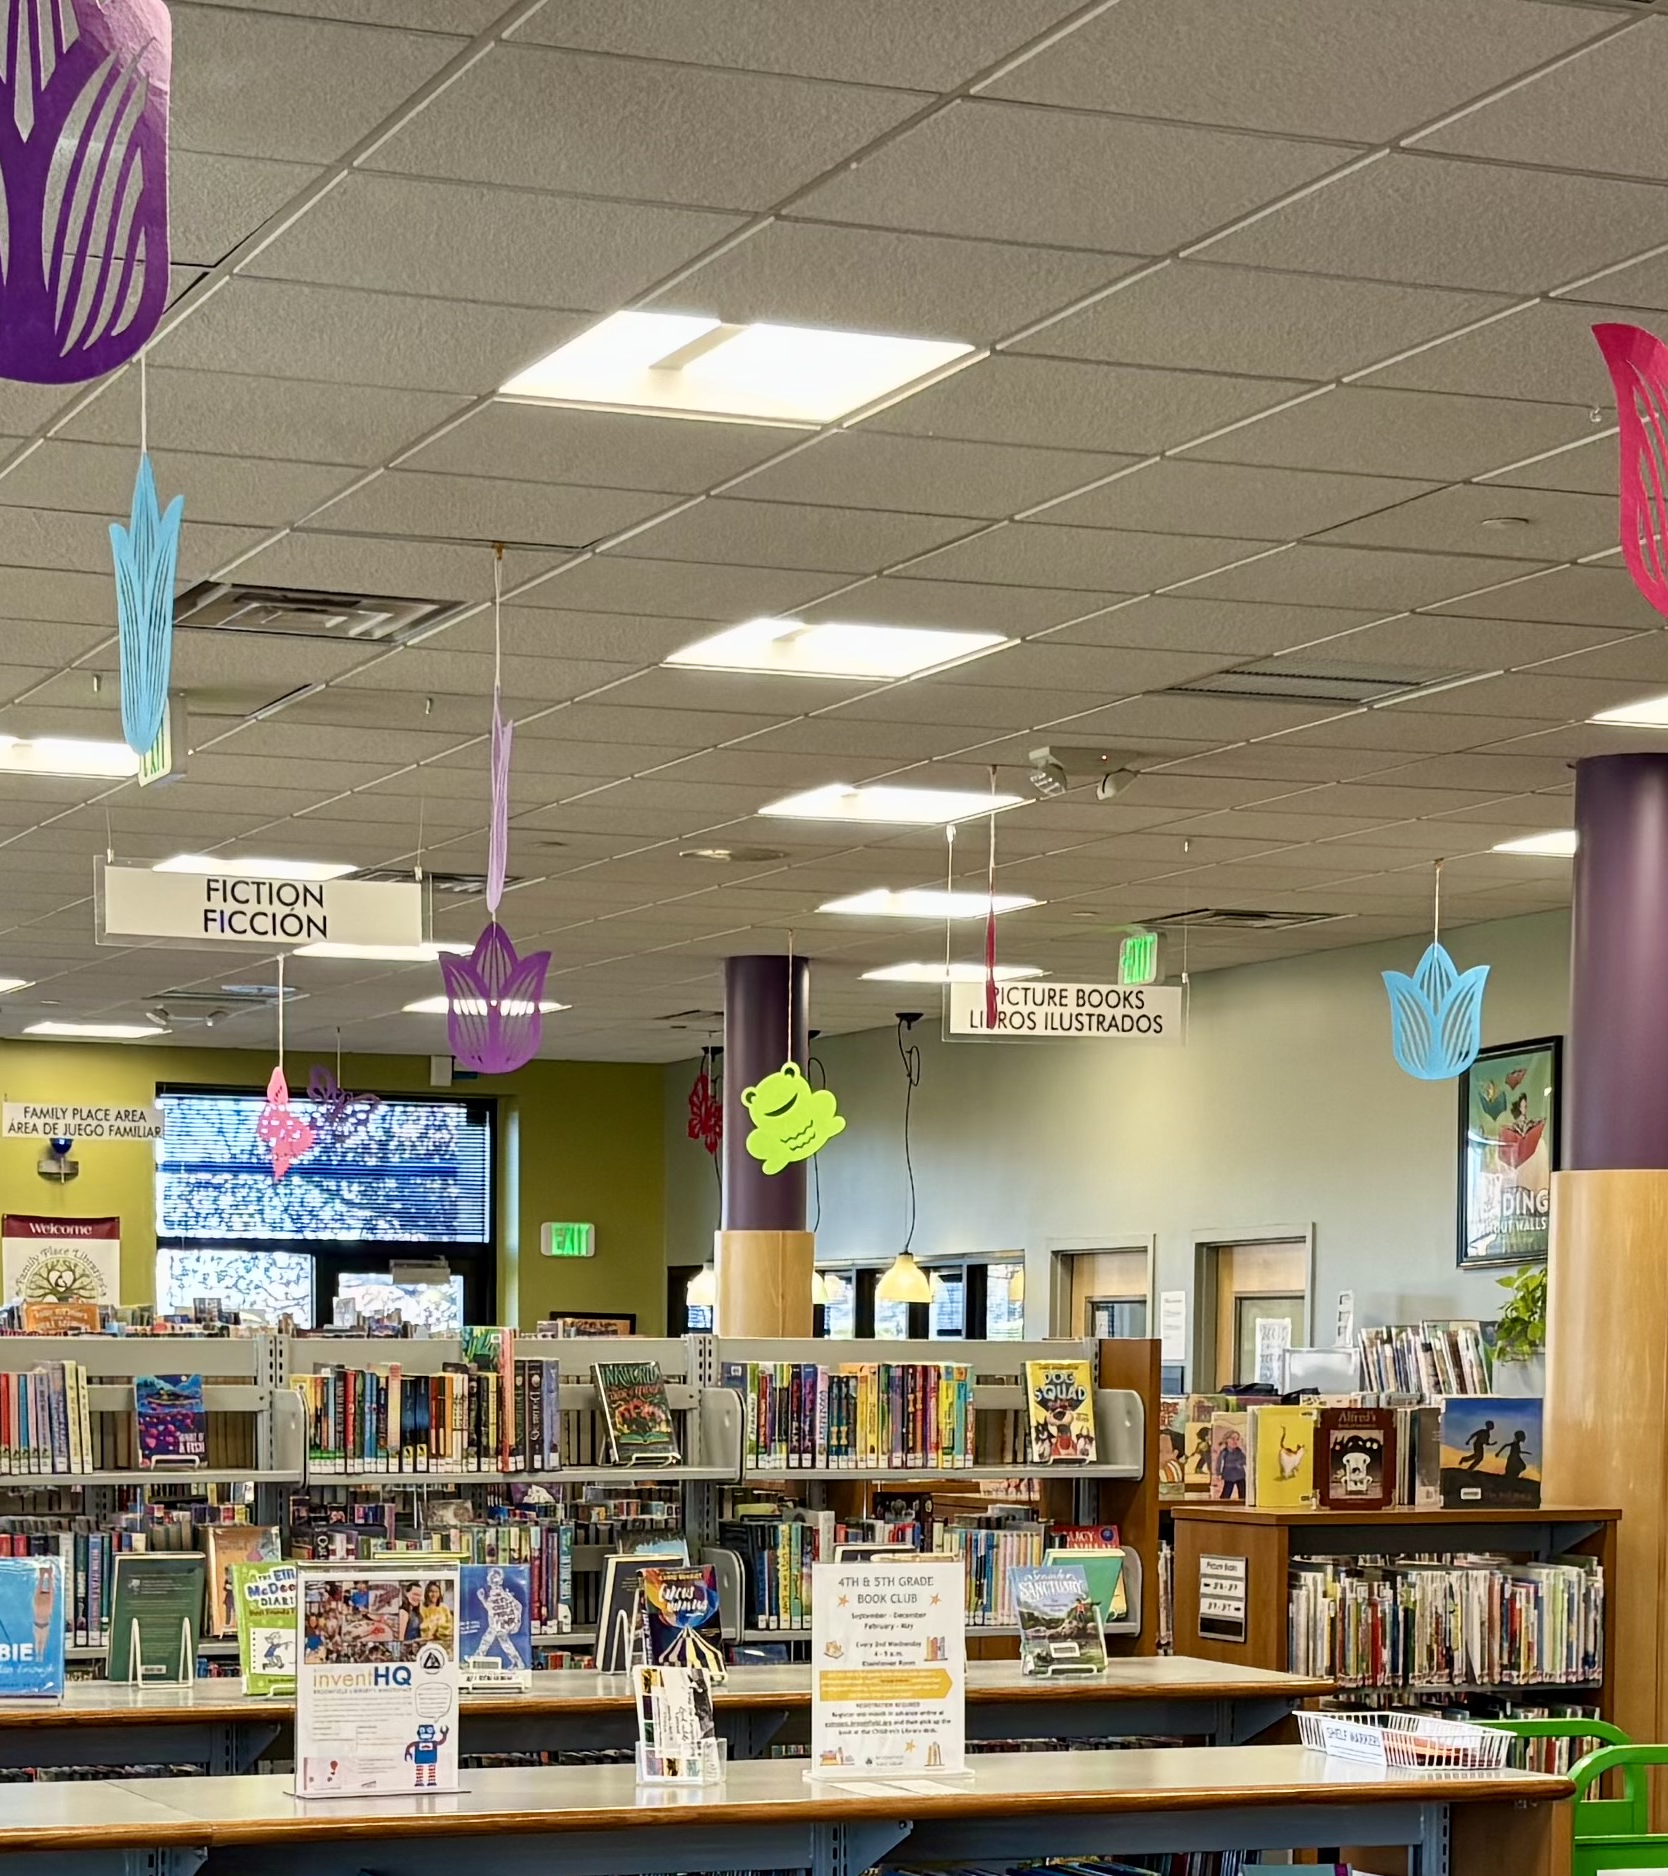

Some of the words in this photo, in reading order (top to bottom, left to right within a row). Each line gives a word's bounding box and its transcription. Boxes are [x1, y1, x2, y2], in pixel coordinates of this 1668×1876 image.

[206, 878, 325, 909] FICTION
[202, 907, 330, 940] FICCIÓN
[1076, 988, 1144, 1010] BOOKS
[970, 1009, 1037, 1030] LIROS
[1045, 1011, 1163, 1034] ILUSTRADOS
[23, 1106, 68, 1121] FAMILY
[72, 1107, 111, 1122] PLACE
[115, 1109, 147, 1122] AREA
[8, 1118, 39, 1134] ÁREA
[43, 1122, 59, 1135] DE
[63, 1122, 104, 1137] JUEGO
[108, 1124, 162, 1138] FAMILIAR
[29, 1222, 93, 1235] Welcome
[1044, 1371, 1076, 1383] DOG
[1034, 1384, 1087, 1401] SQUAD
[1338, 1410, 1376, 1422] Alfred's
[838, 1577, 860, 1588] 4TH
[863, 1576, 871, 1587] &
[874, 1576, 895, 1588] 5TH
[899, 1576, 934, 1587] GRADE
[857, 1594, 887, 1604] BOOK
[890, 1593, 917, 1604] CLUB
[313, 1666, 412, 1688] inventHQ
